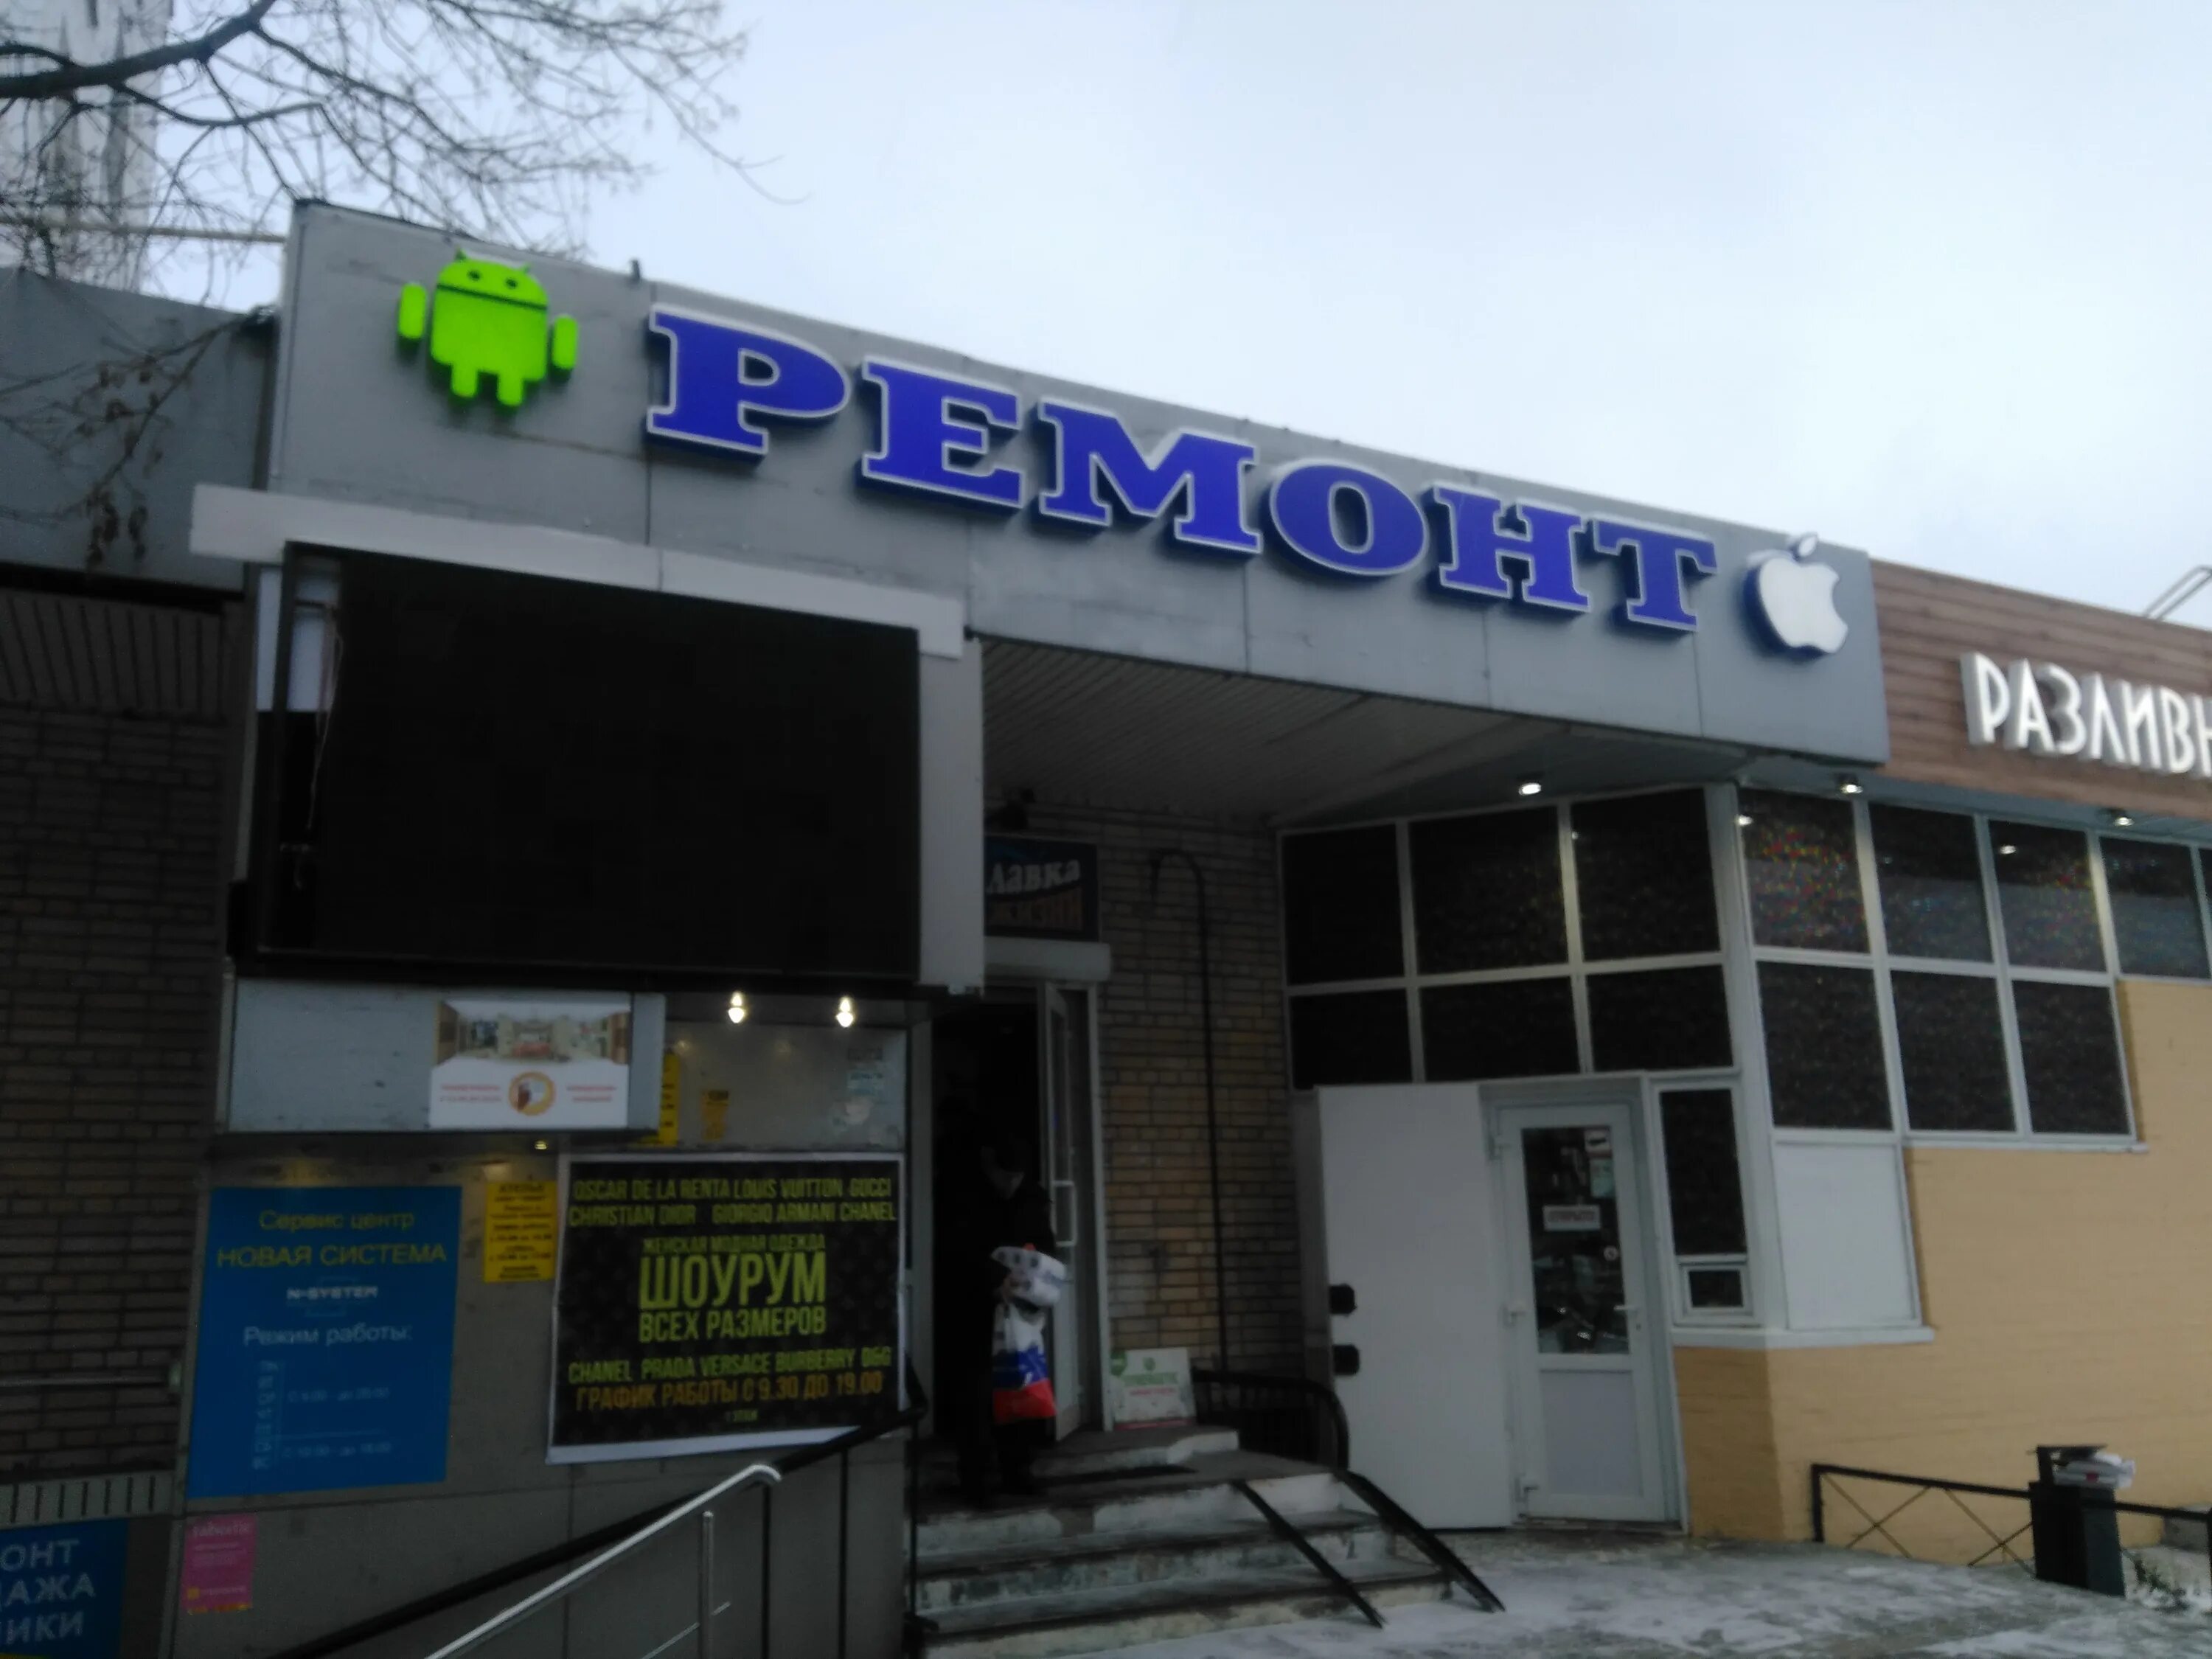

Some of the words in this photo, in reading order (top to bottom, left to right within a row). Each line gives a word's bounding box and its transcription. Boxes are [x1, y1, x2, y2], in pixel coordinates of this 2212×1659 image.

[647, 305, 1718, 633] РЕМОНТ
[574, 1180, 627, 1200] OSCAR
[632, 1180, 653, 1200] DE
[656, 1179, 676, 1200] LA
[680, 1178, 730, 1200] RENTA
[734, 1179, 777, 1199] LOUIS
[780, 1178, 843, 1198] VUITTON
[849, 1178, 891, 1197] GUCCI
[259, 1209, 344, 1232] Сервис
[350, 1212, 415, 1230] центр
[569, 1204, 655, 1227] CHRISTIAN
[777, 1202, 836, 1222] ARMANI
[840, 1201, 897, 1221] CHANEL
[216, 1244, 312, 1268] НОВАЯ
[320, 1242, 447, 1265] СИСТЕМА
[639, 1251, 826, 1310] ШОУРУМ
[639, 1310, 700, 1343] ВСЕХ
[706, 1306, 826, 1339] РАЗМЕРОВ
[568, 1361, 633, 1384] CHANEL
[641, 1357, 695, 1380] PRADA
[699, 1352, 771, 1377] VERSACE
[775, 1349, 855, 1373] BURBERRY
[577, 1383, 656, 1411] ГРАФИК
[661, 1379, 737, 1408] РАБОТЫ
[742, 1378, 754, 1402] С
[759, 1375, 799, 1402] 9.30
[804, 1374, 829, 1401] ДО
[836, 1370, 883, 1396] 19.00
[0, 1538, 80, 1571] ОНТ
[0, 1572, 97, 1611] АЖА
[0, 1610, 85, 1644] ИКИ
